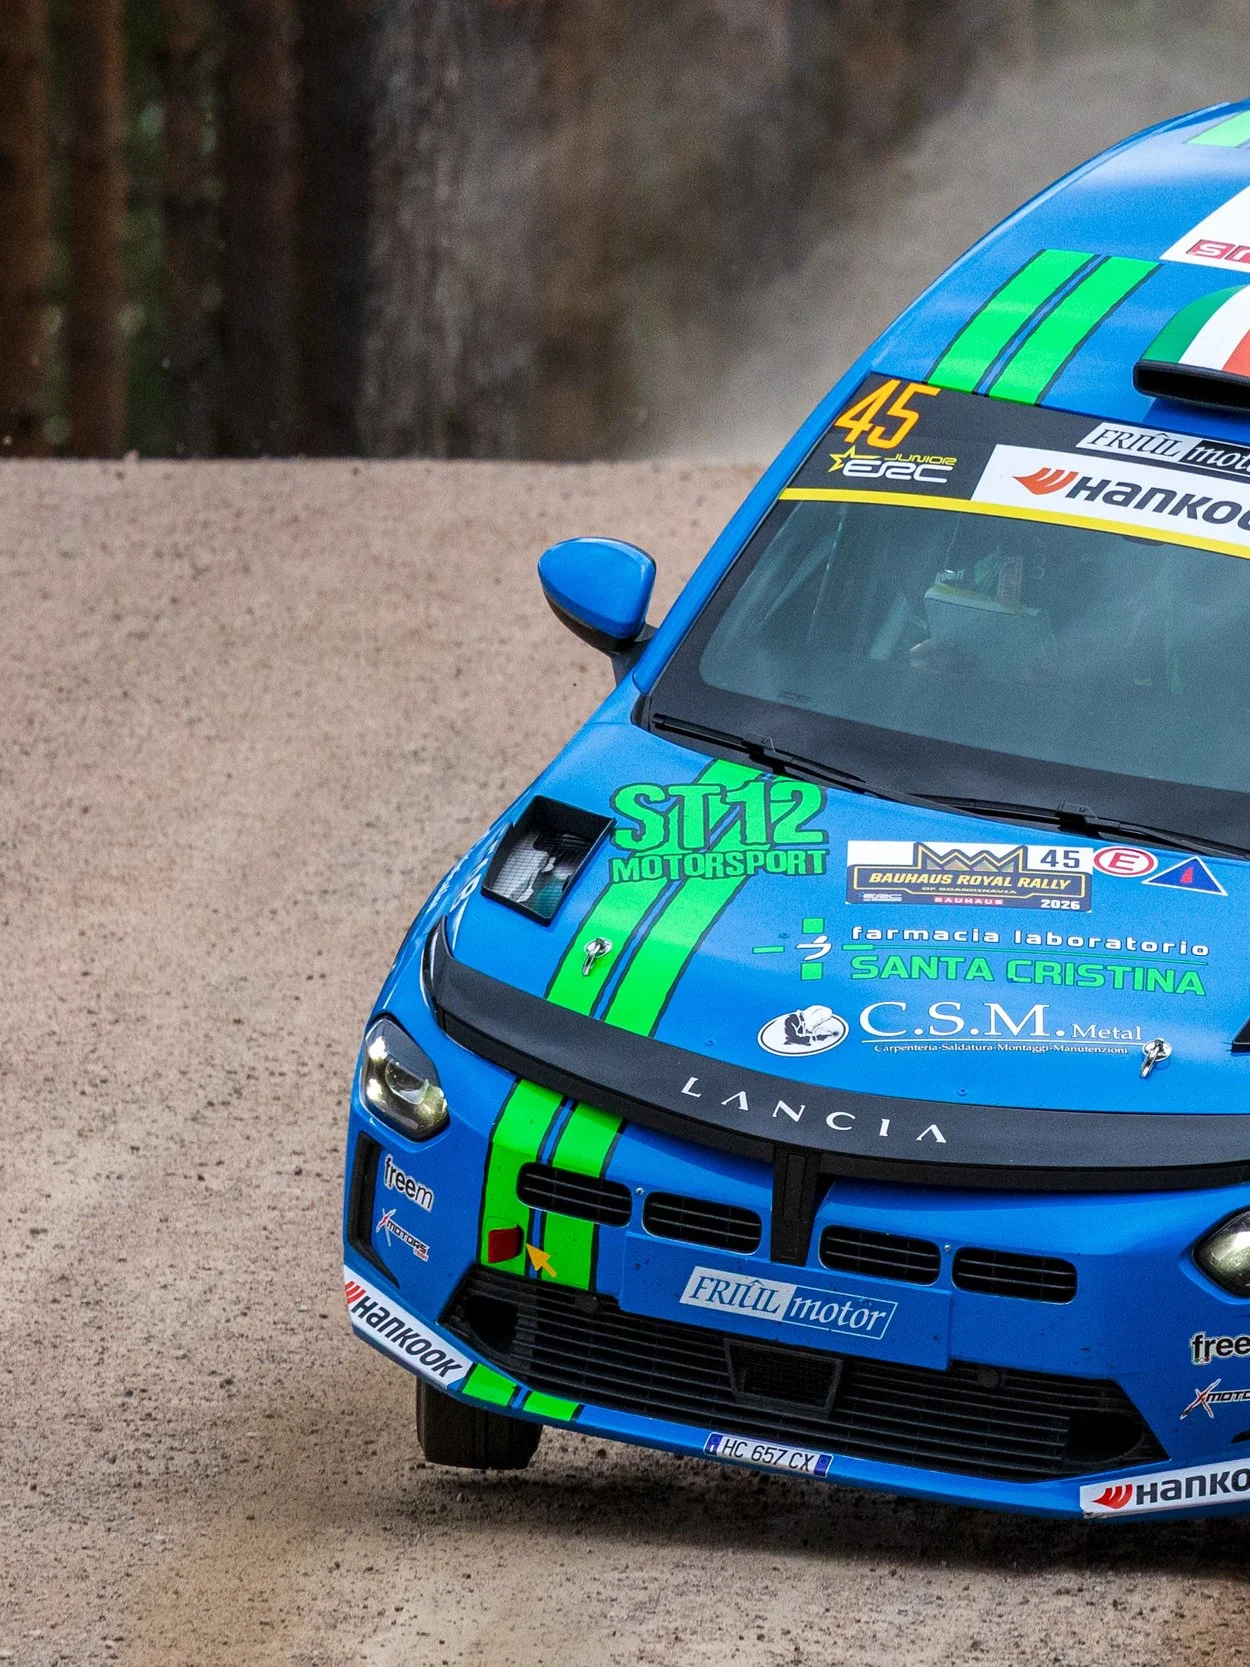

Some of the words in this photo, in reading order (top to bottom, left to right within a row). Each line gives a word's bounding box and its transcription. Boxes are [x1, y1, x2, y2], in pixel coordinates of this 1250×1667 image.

[835, 379, 941, 449] 45
[843, 459, 953, 483] ERC
[884, 453, 957, 466] JUNIOR
[610, 780, 828, 851] ST12
[609, 850, 829, 882] MOTORSPORT
[1040, 850, 1080, 869] 45
[1108, 852, 1140, 871] E
[869, 872, 952, 885] BAUHAUS
[957, 874, 1012, 888] ROYAL
[1018, 877, 1071, 890] RALLY
[934, 896, 1004, 905] BAUHAUS
[1040, 899, 1080, 910] 2026
[852, 926, 1000, 944] farmacia
[1014, 930, 1209, 956] laboratorio
[850, 955, 994, 981] SANTA
[1006, 959, 1206, 996] CRISTINA
[859, 1001, 1065, 1037] C.S.M.
[1072, 1023, 1142, 1041] Metal
[681, 1076, 947, 1144] LANCIA
[385, 1155, 433, 1211] freem
[790, 1296, 887, 1331] motor
[722, 1439, 748, 1458] HC
[751, 1445, 788, 1465] 657
[789, 1452, 815, 1472] CX
